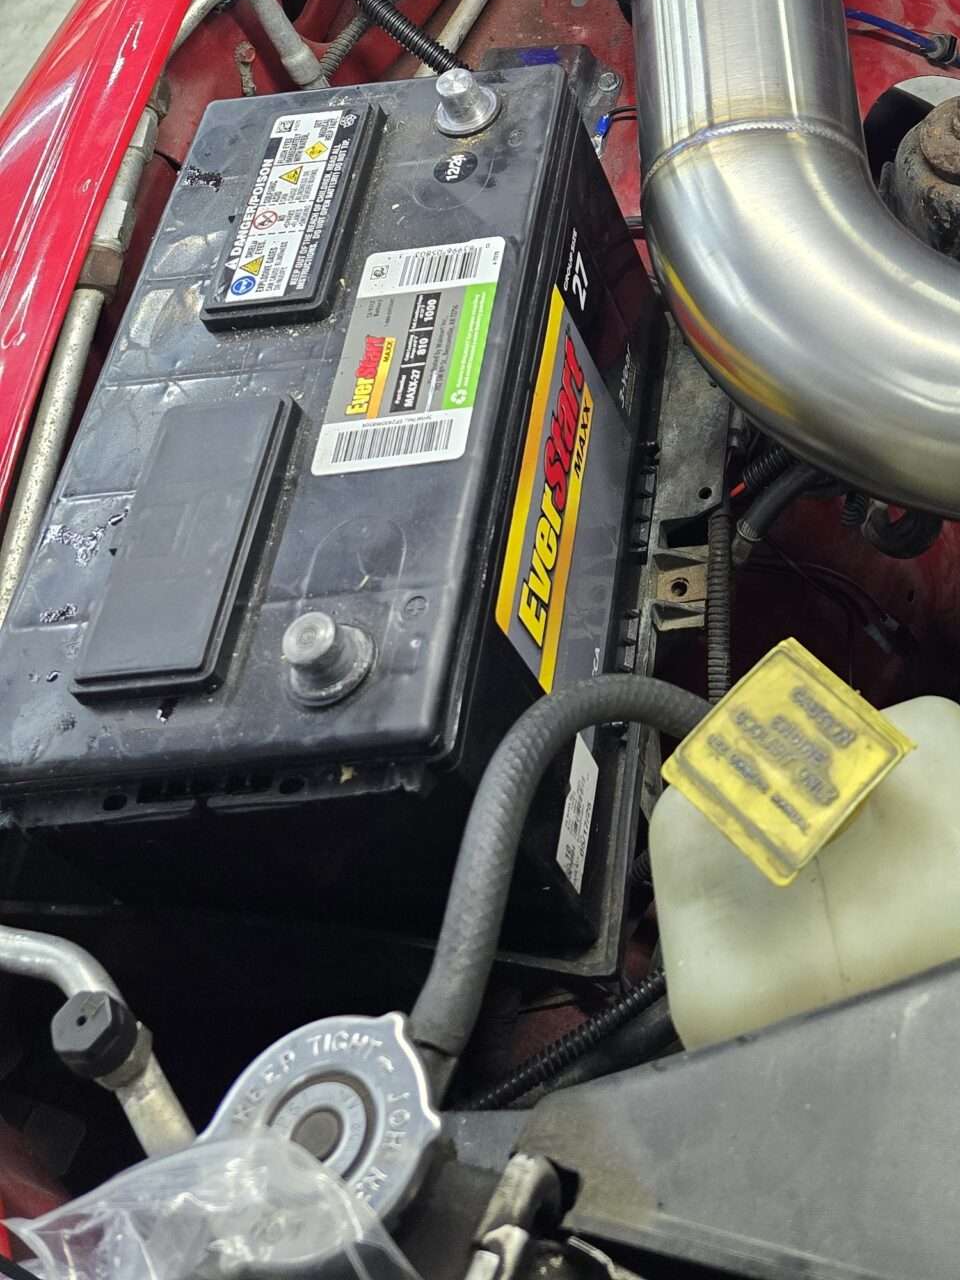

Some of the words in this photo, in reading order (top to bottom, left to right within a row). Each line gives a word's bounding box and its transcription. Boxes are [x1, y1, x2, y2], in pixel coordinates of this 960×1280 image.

[229, 157, 274, 256] DANGER/POISON
[288, 270, 300, 284] KEEP
[306, 212, 319, 231] REACH
[572, 251, 589, 312] 27
[415, 336, 429, 355] 810
[422, 298, 438, 322] 1000
[344, 334, 385, 415] EverStart
[383, 340, 393, 362] MAXX
[402, 368, 421, 407] MAXX-27
[574, 400, 592, 480] MAXX
[518, 335, 585, 649] EverStart
[233, 1049, 297, 1121] KEEP
[307, 1029, 383, 1060] TIGHT
